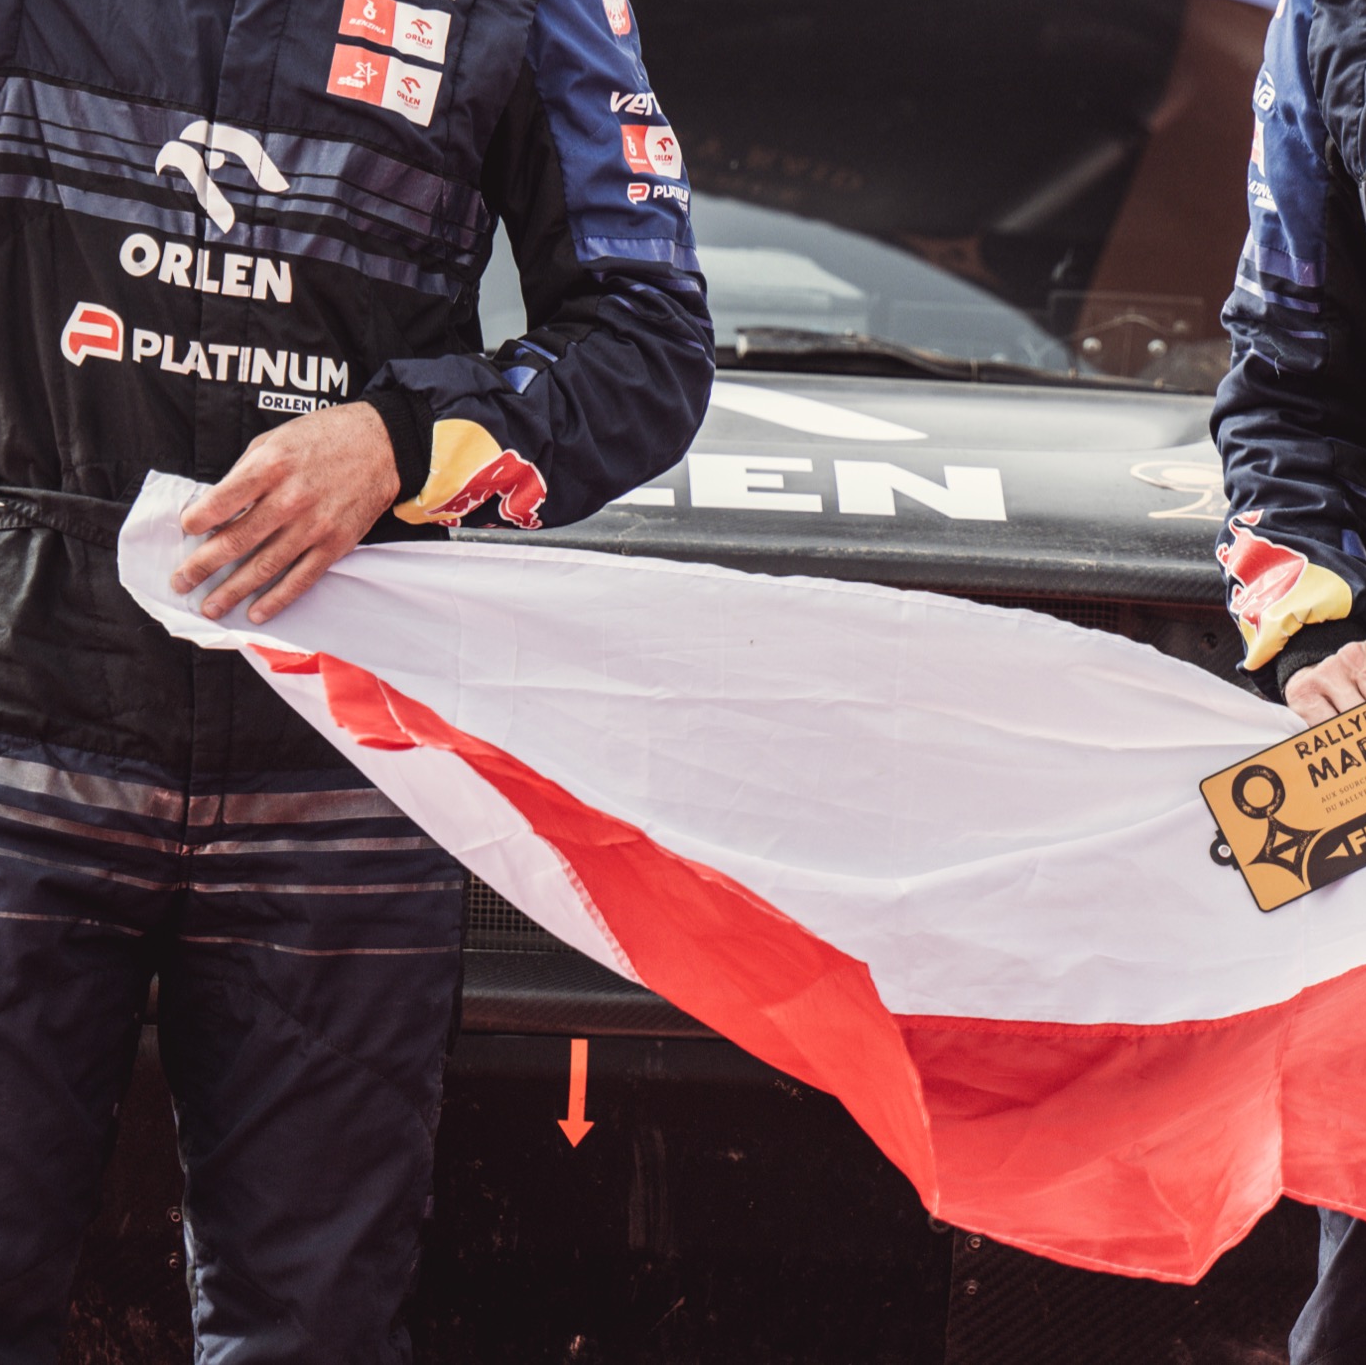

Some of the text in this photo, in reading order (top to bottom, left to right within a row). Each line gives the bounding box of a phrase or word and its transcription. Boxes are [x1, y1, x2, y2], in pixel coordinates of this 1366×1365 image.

[348, 17, 387, 35] BENZINA
[405, 32, 433, 46] ORLEN
[337, 75, 366, 89] star
[396, 89, 421, 106] ORLEN
[119, 233, 293, 303] ORLEN
[132, 328, 349, 397] PLATINUM
[261, 394, 313, 413] ORLEN
[1321, 791, 1337, 804] AUX
[1325, 803, 1337, 814] DU
